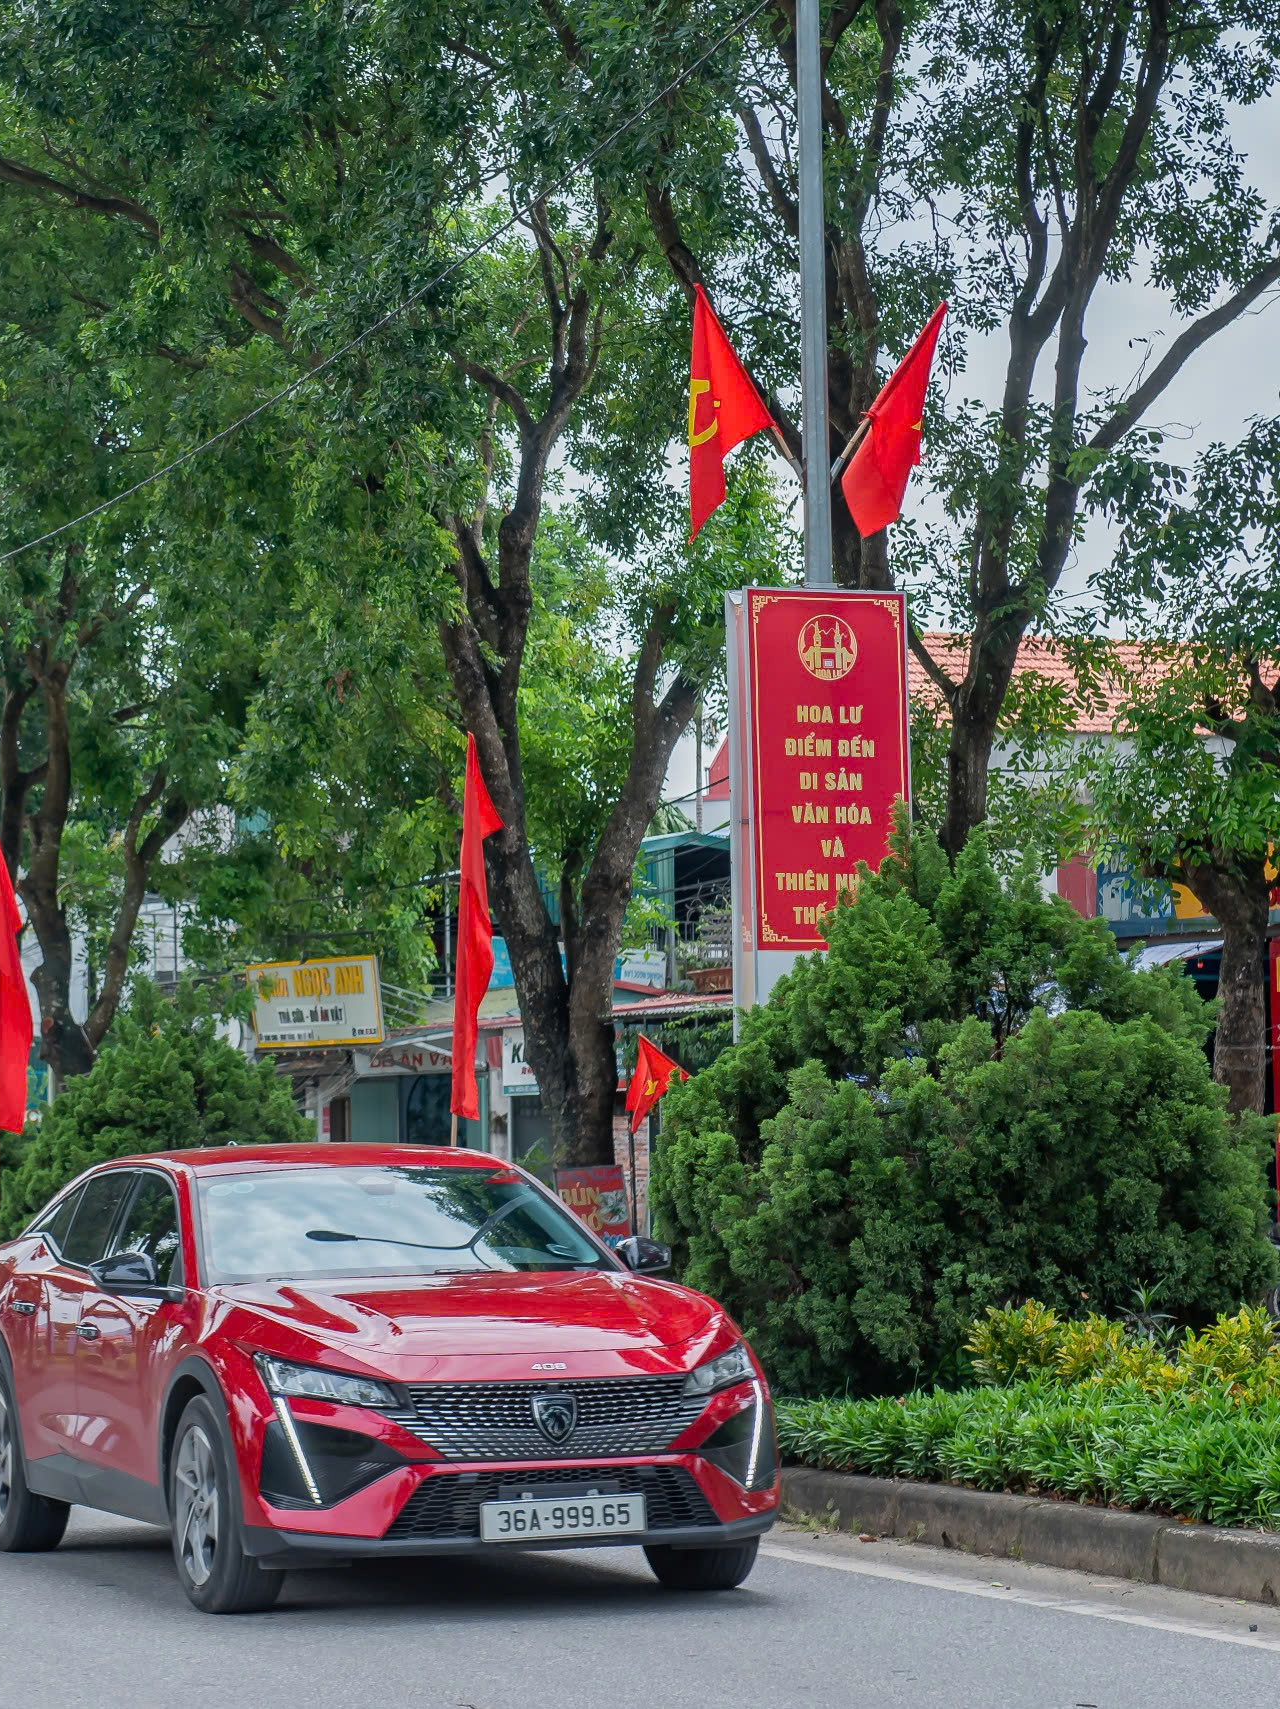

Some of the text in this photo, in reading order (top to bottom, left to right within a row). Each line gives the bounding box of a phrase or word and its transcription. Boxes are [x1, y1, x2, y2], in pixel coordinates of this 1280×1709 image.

[796, 704, 864, 724] HOA LƯ
[784, 731, 875, 758] ĐIỂM ĐẾN
[799, 767, 863, 791] DI SẢN
[791, 802, 872, 825] VĂN HÓA
[820, 836, 845, 858] VÀ
[775, 869, 829, 891] THIÊN
[334, 965, 365, 994] ANH
[498, 1503, 631, 1533] 36A-999.65
